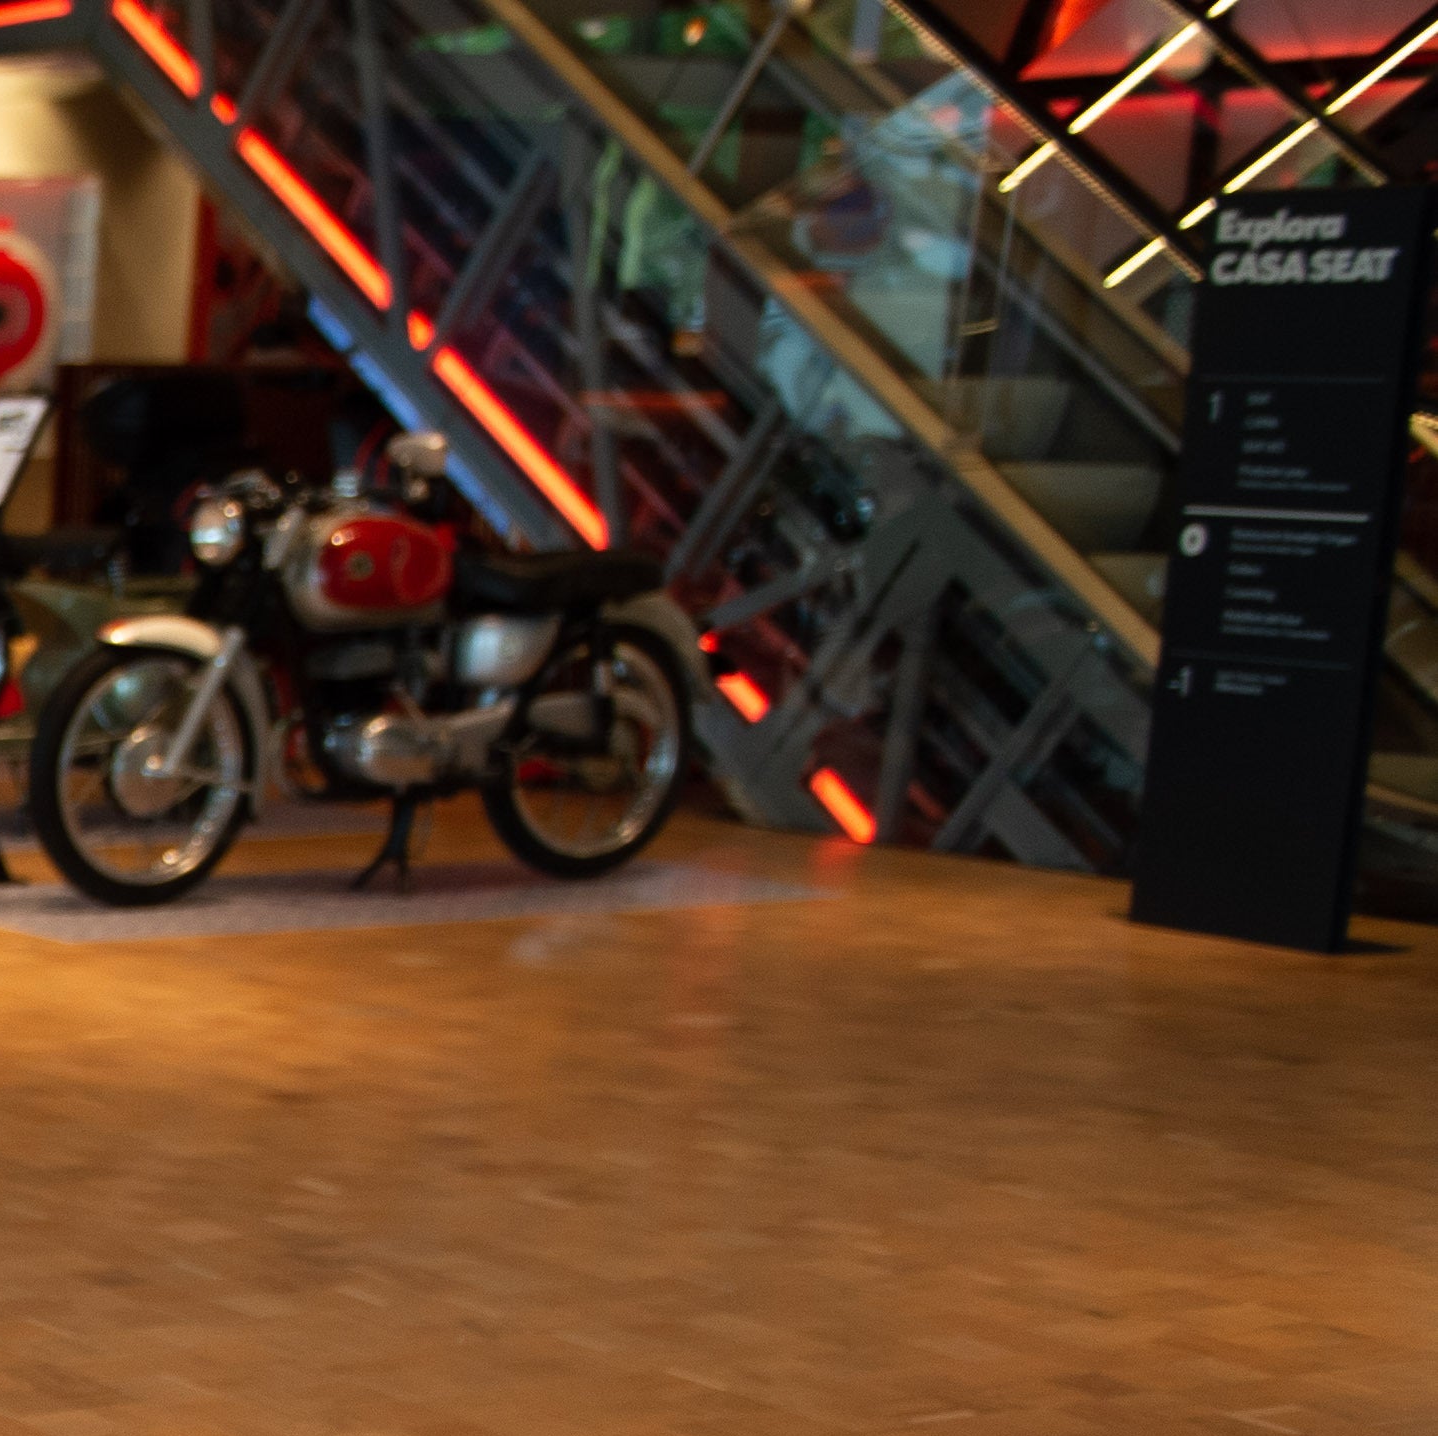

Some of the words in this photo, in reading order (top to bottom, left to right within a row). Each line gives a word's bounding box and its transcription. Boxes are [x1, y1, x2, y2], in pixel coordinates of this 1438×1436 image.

[1217, 208, 1346, 248] Explora
[1211, 250, 1307, 285] CASA
[1308, 248, 1401, 284] SEAT
